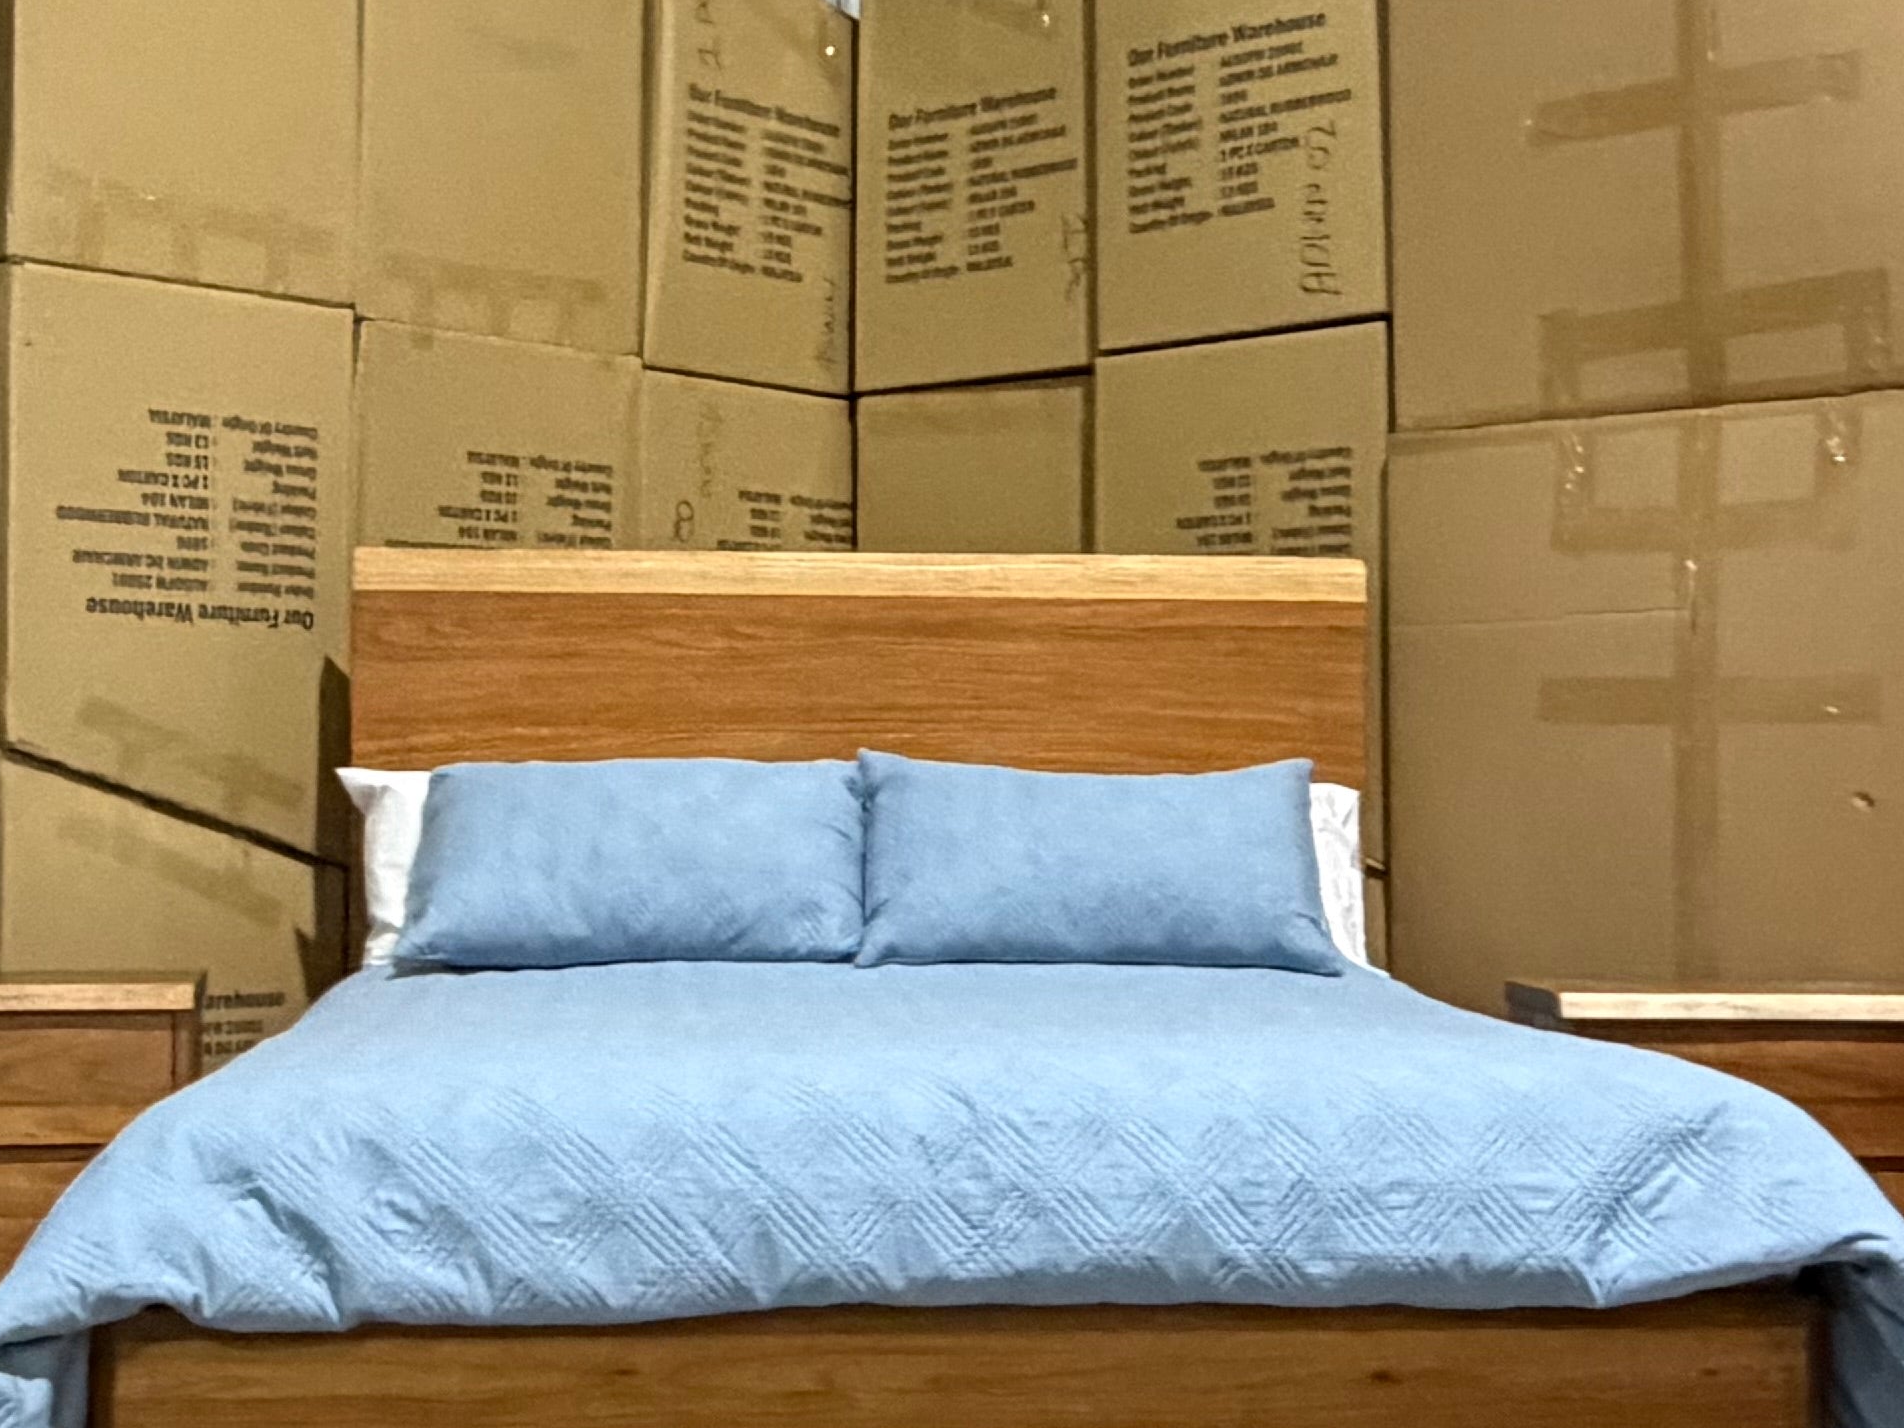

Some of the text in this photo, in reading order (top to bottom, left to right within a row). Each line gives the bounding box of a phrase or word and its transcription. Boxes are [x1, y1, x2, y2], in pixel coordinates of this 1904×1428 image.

[86, 597, 314, 631] Our Furniture Warehouse
